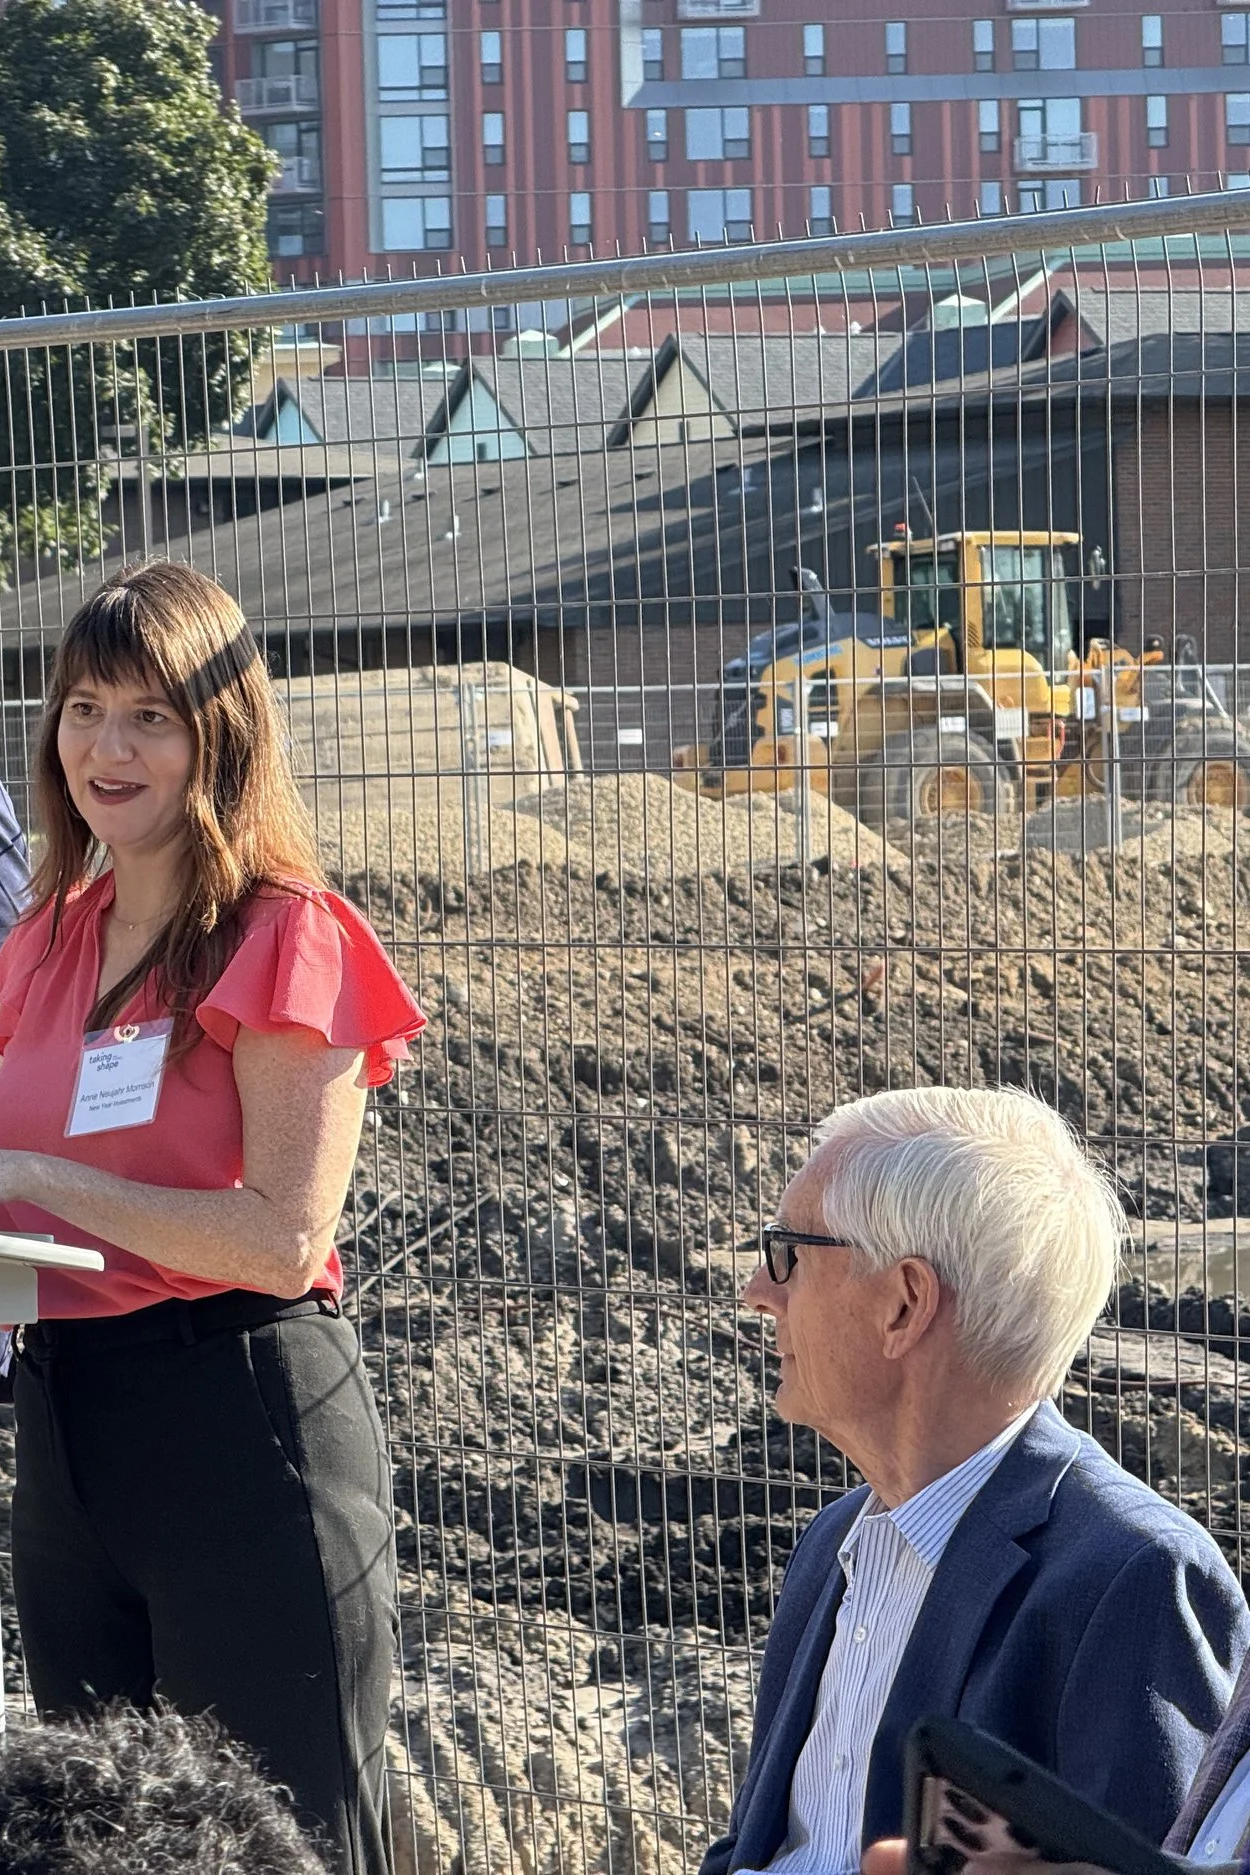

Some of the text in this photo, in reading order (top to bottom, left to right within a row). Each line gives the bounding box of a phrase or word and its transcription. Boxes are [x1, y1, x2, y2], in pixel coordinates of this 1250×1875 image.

[88, 1052, 113, 1064] taking
[96, 1061, 119, 1072] shape
[80, 1094, 98, 1103] Anne
